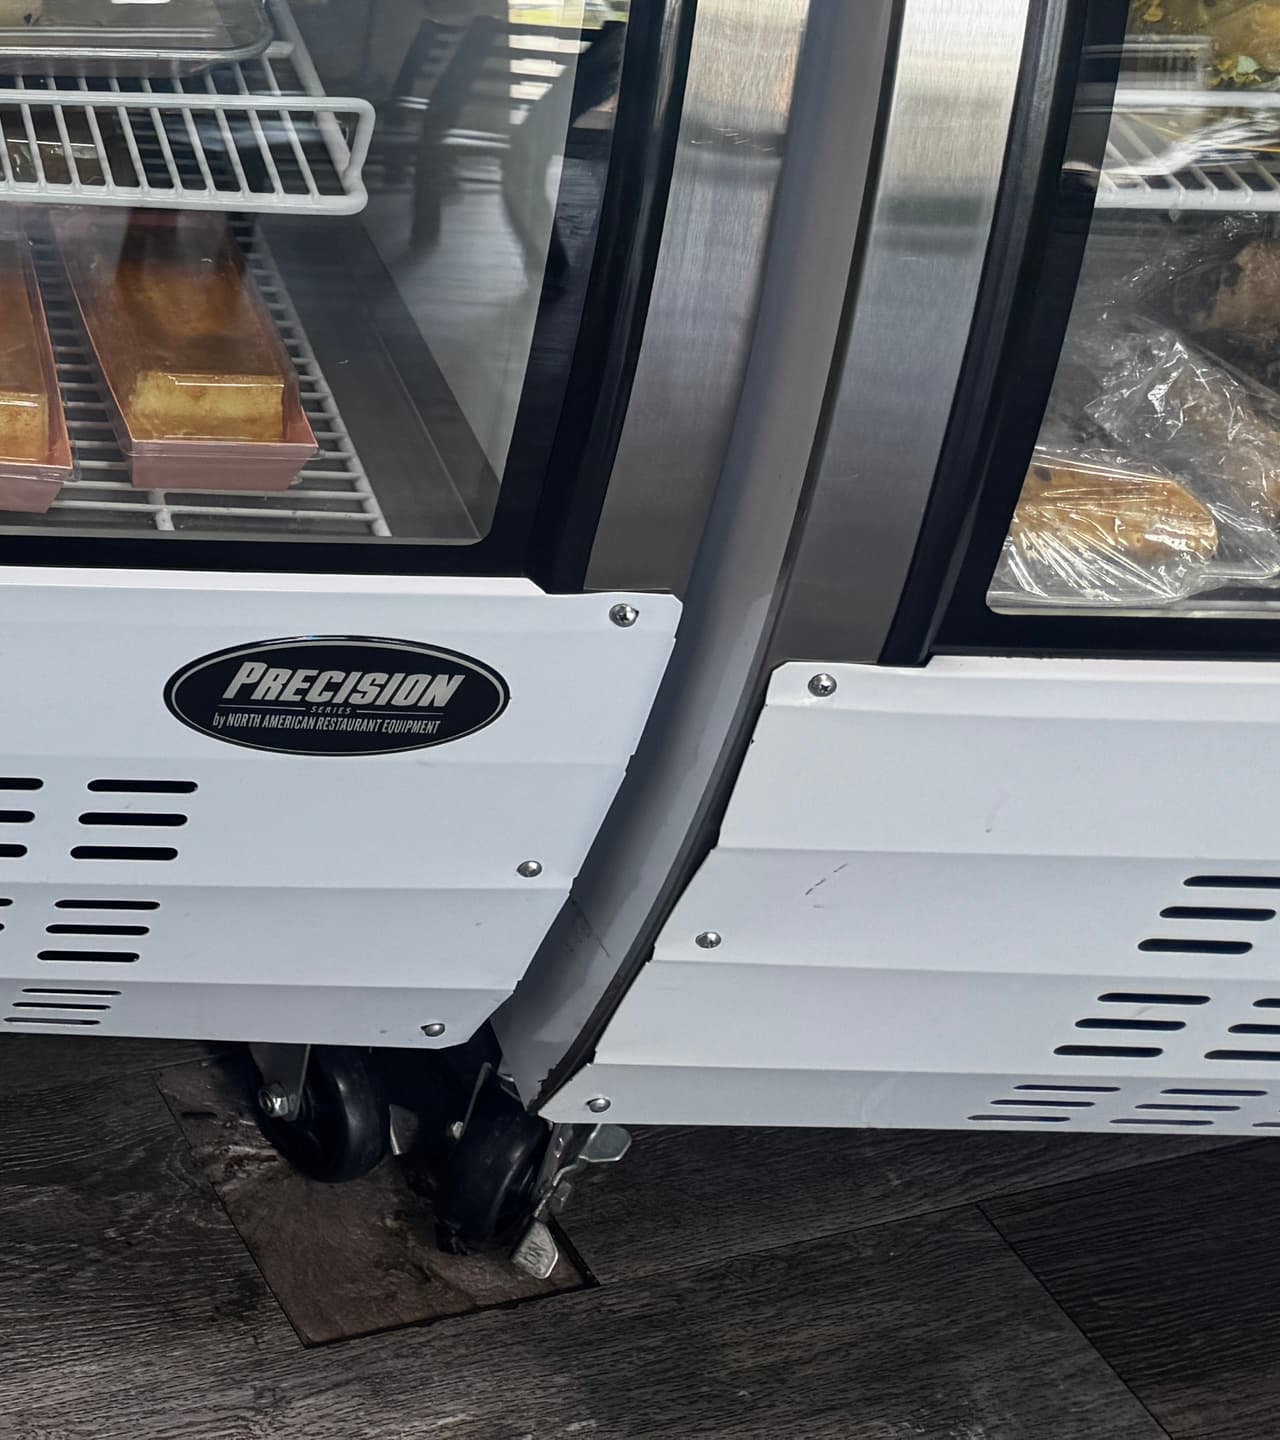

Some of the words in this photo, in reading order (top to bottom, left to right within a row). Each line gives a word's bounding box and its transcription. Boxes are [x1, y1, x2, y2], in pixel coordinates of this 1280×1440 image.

[221, 661, 466, 708] PRECISION
[309, 705, 352, 715] SERIES
[212, 712, 226, 729] by
[226, 713, 261, 729] NORTH
[261, 714, 316, 731] AMERICAN
[316, 717, 382, 733] RESTAURANT
[381, 719, 441, 735] EQUIPMENT
